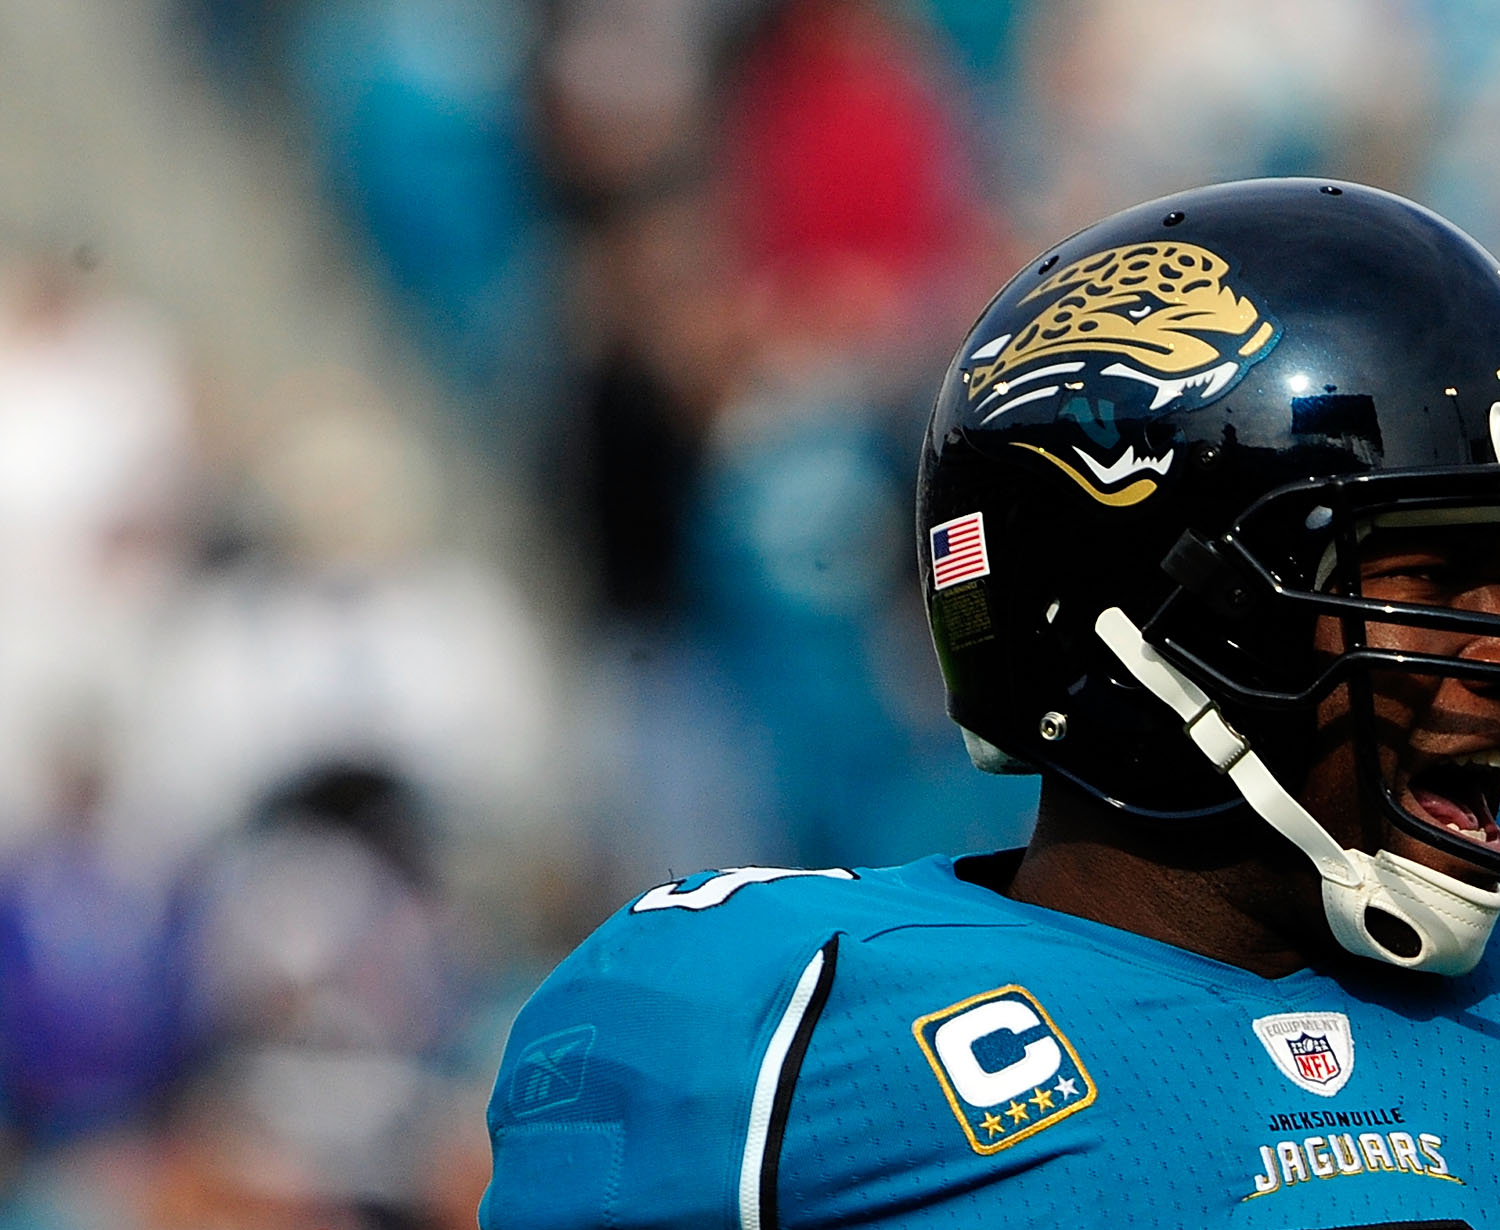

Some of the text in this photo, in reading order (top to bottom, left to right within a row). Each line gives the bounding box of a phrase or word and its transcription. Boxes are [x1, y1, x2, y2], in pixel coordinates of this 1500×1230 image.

[1265, 1018, 1340, 1037] EQUIPMENT
[935, 1000, 1062, 1107] C
[1297, 1054, 1337, 1079] NFL
[1269, 1107, 1405, 1132] JACKSONVILLE
[1253, 1132, 1450, 1194] JAGUARS
